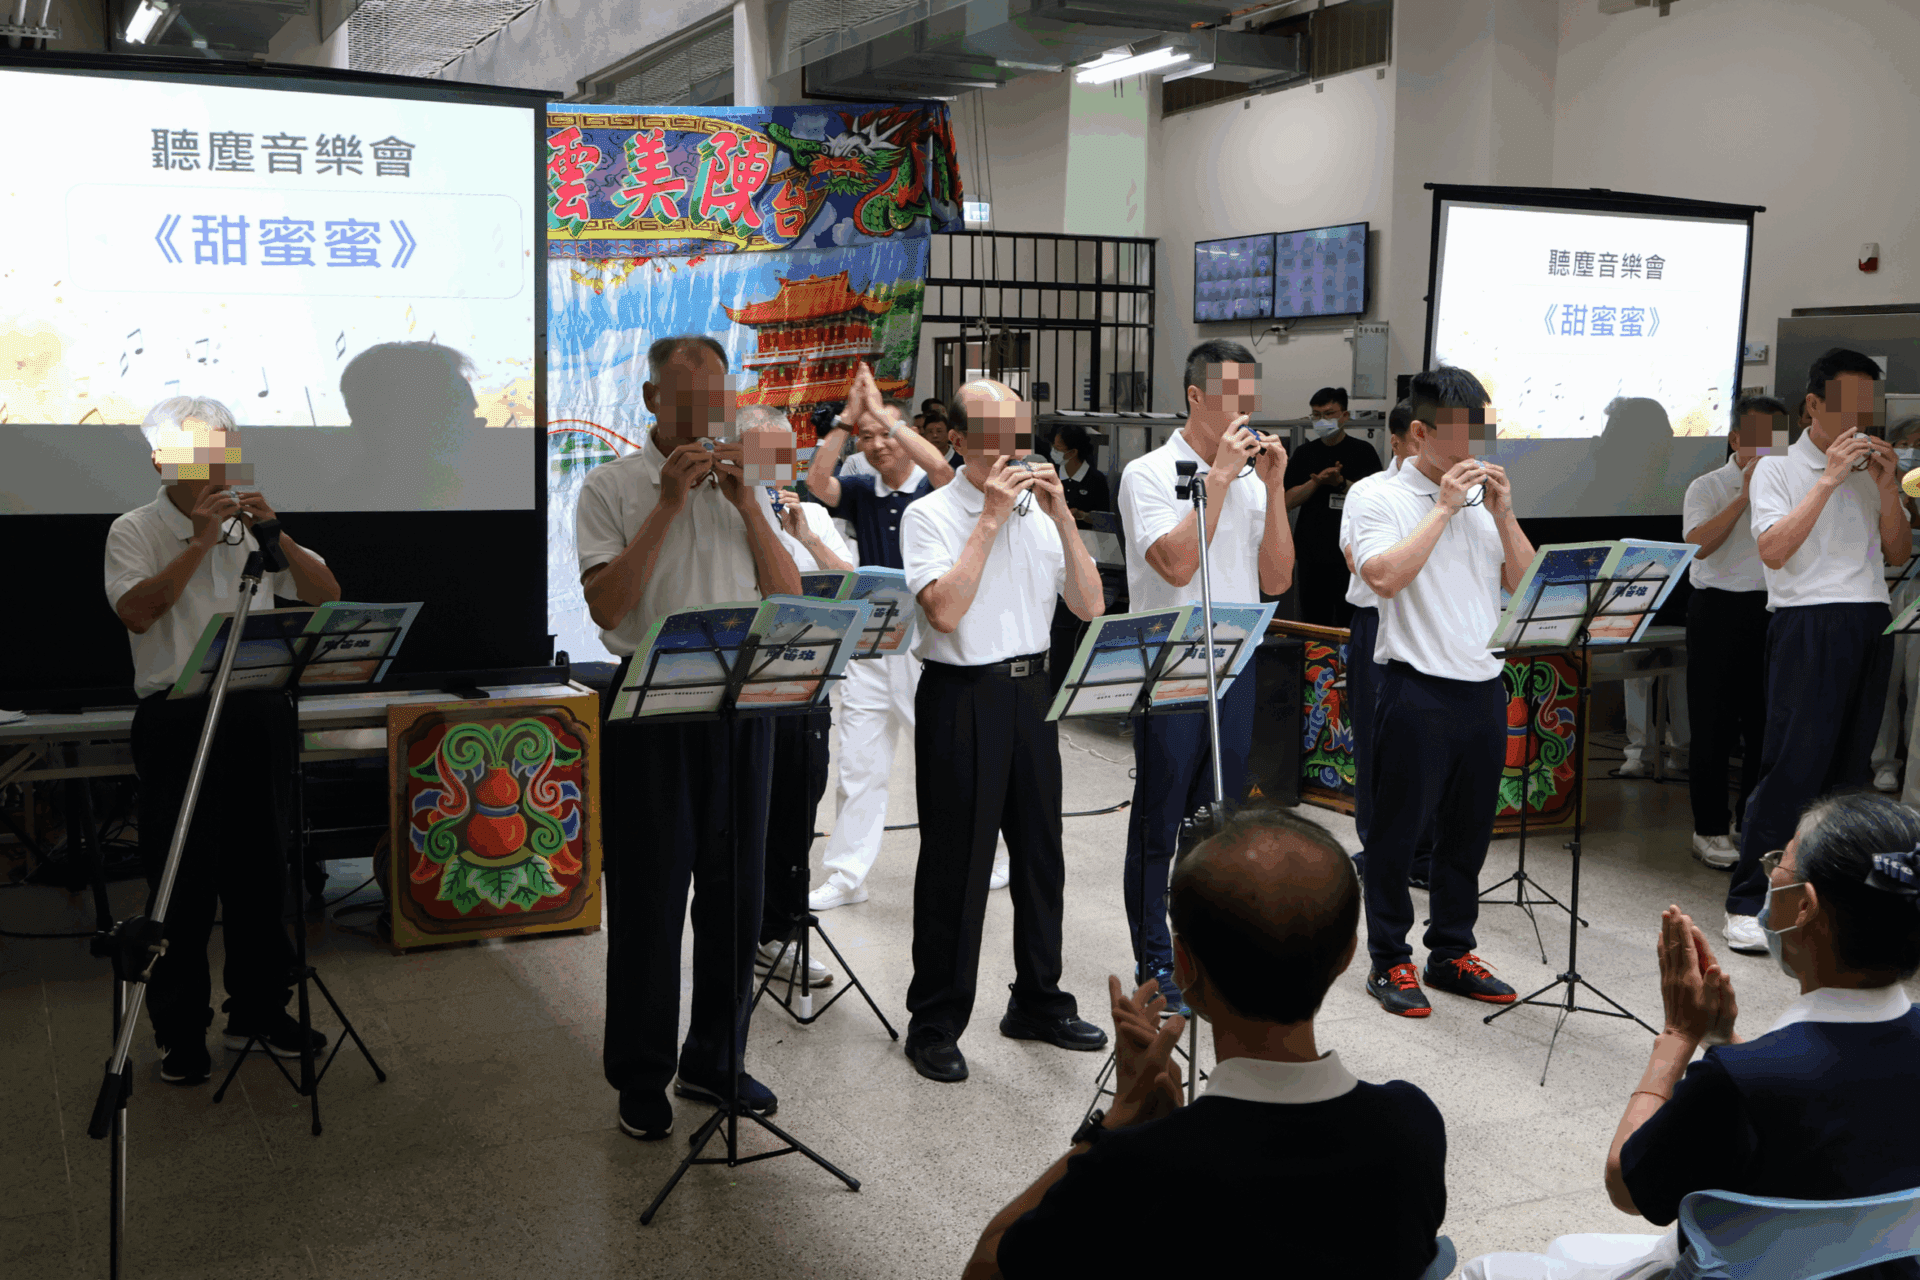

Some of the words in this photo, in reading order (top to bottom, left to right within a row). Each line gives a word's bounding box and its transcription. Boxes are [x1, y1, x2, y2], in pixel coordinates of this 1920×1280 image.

[151, 128, 416, 178] 聽塵音樂會
[155, 213, 417, 269] 《甜蜜蜜》
[1548, 249, 1666, 280] 聽塵音樂會
[1544, 303, 1660, 337] 《甜蜜蜜》
